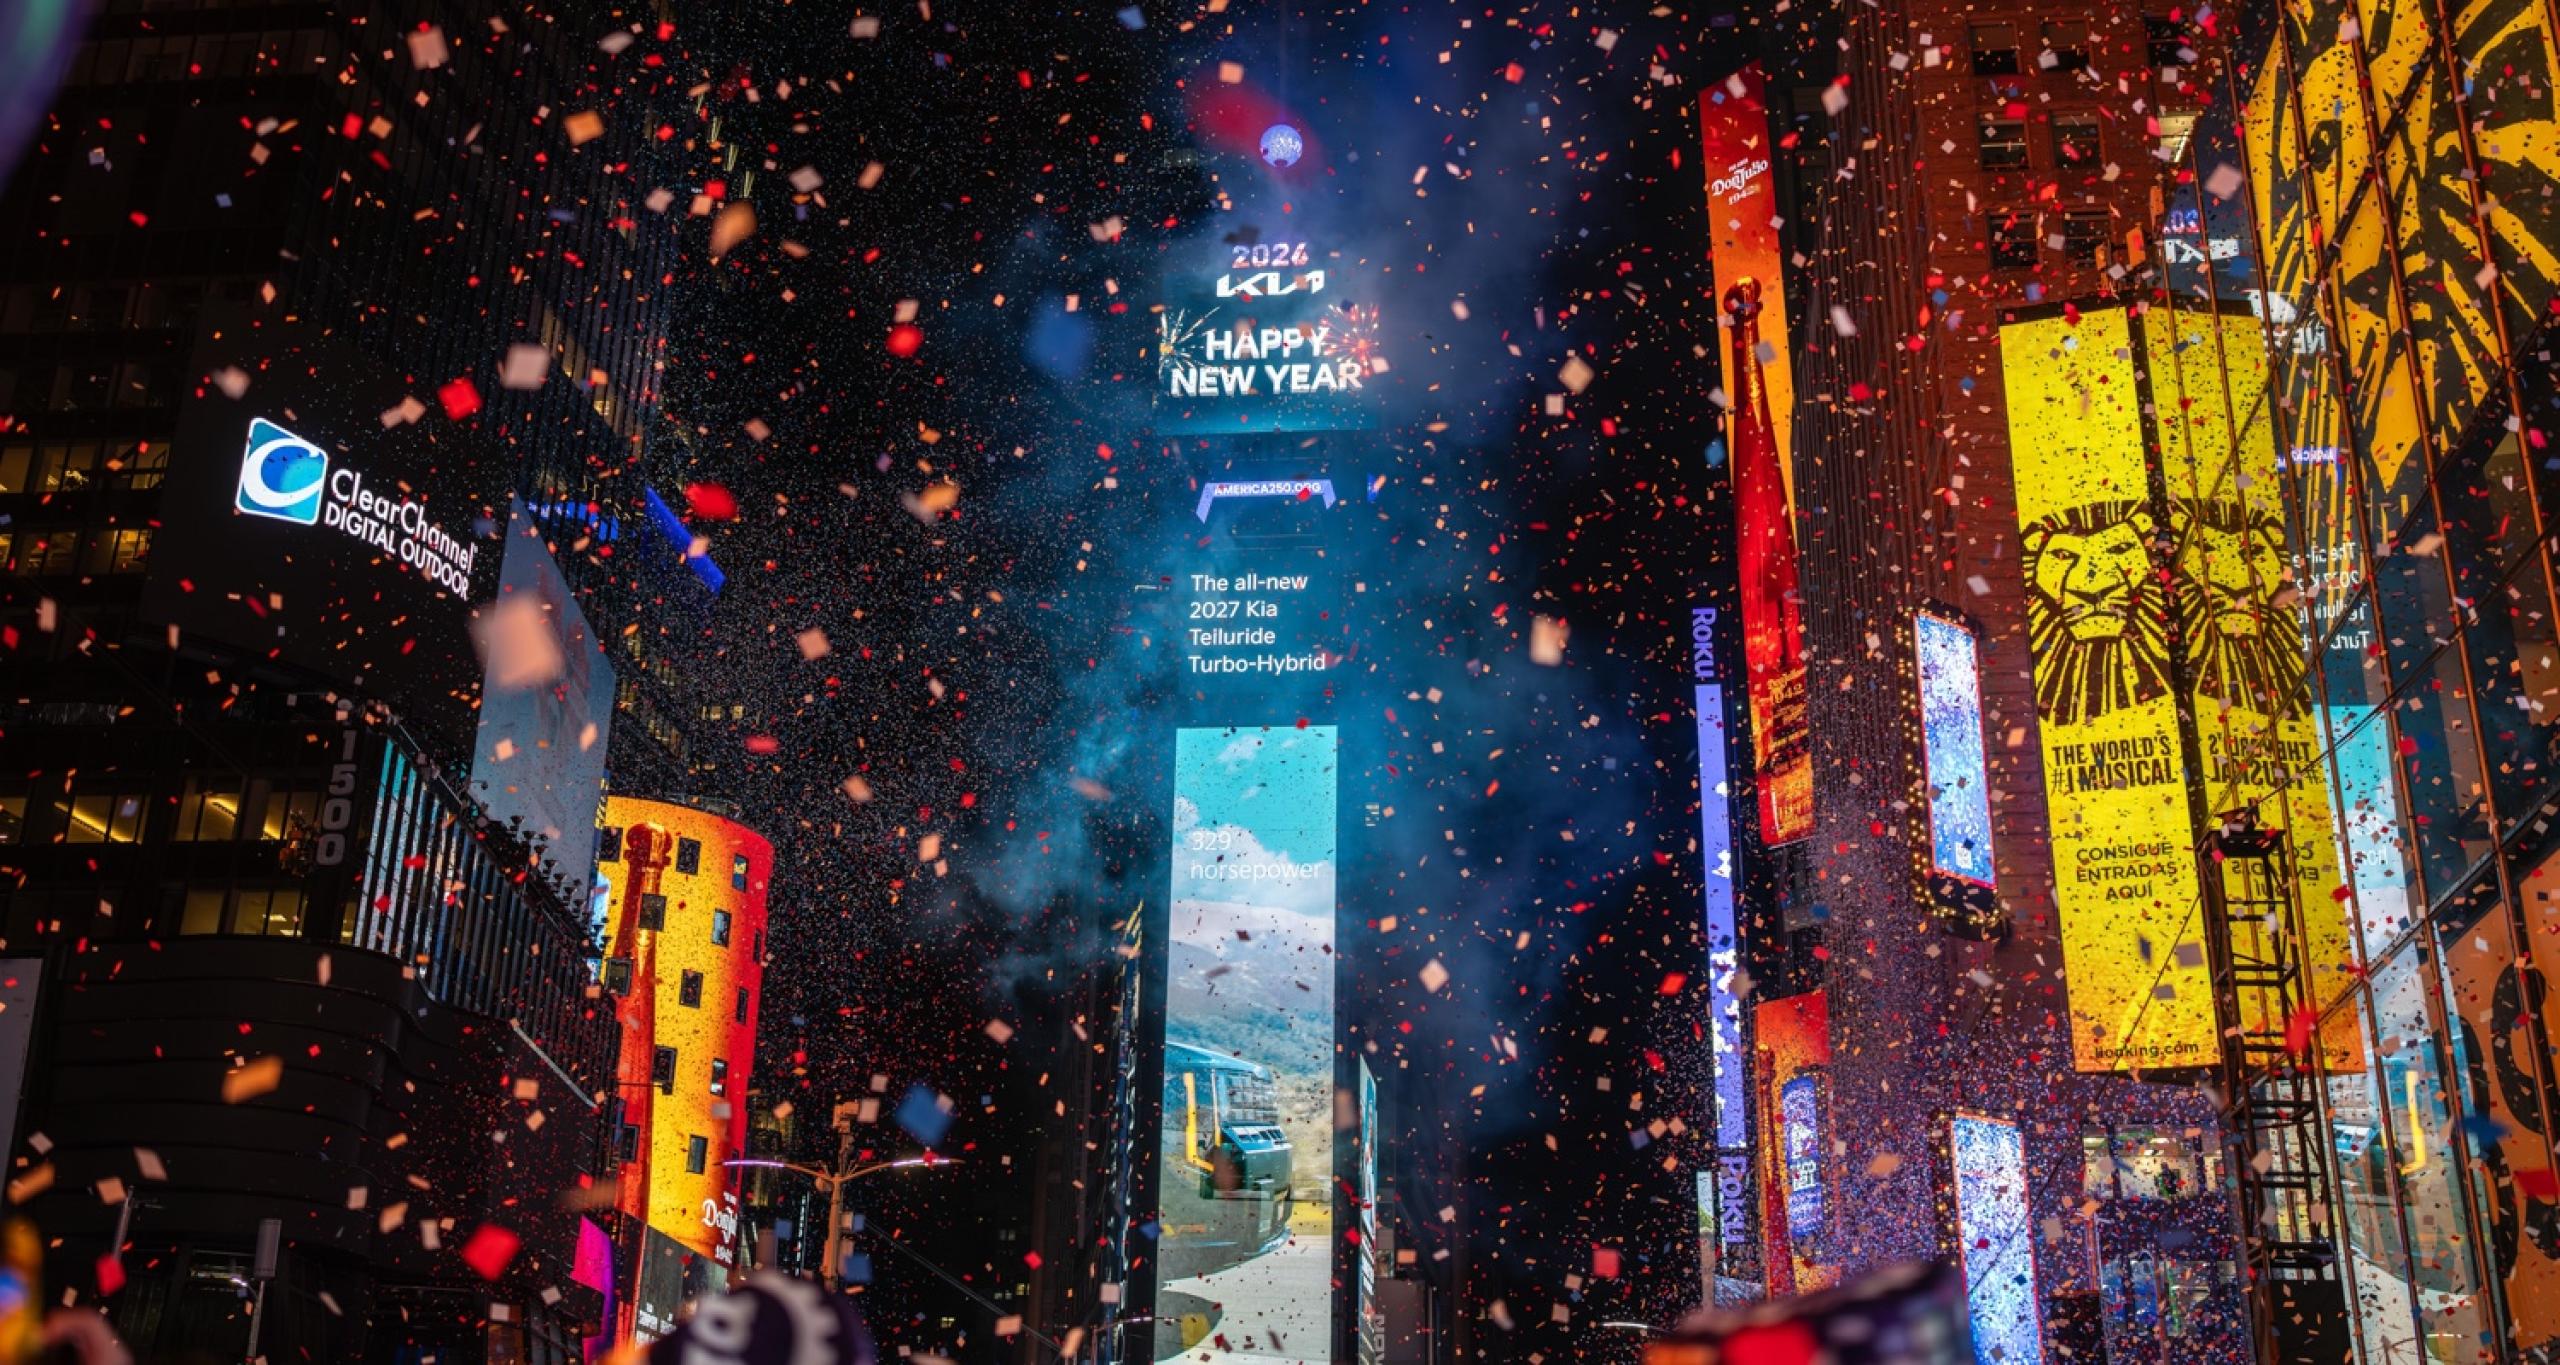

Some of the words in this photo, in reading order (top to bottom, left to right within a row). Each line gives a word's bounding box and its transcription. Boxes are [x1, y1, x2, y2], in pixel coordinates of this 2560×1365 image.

[1231, 242, 1309, 268] 2026
[1205, 326, 1329, 360] HAPPY
[1170, 364, 1256, 398] NEW
[1265, 362, 1363, 394] YEAR
[325, 501, 397, 555] DIGITAL
[401, 537, 470, 600] OUTDOOR
[1191, 574, 1229, 591] The
[1234, 573, 1308, 591] all-new
[1189, 601, 1239, 619] 2027
[1246, 600, 1278, 617] Kia
[1189, 628, 1276, 646] Telluride
[1188, 652, 1326, 676] Turbo-Hybrid
[2052, 743, 2089, 767] THE
[2091, 735, 2171, 763] WORLD'S
[2078, 758, 2178, 793] MUSICAL
[316, 730, 357, 866] 1500
[1191, 830, 1232, 851] 329
[2076, 840, 2174, 862] CONSIGUE
[1190, 859, 1324, 885] horsepower
[2076, 860, 2178, 883] ENTRADAS
[2105, 880, 2154, 901] AQUÍ
